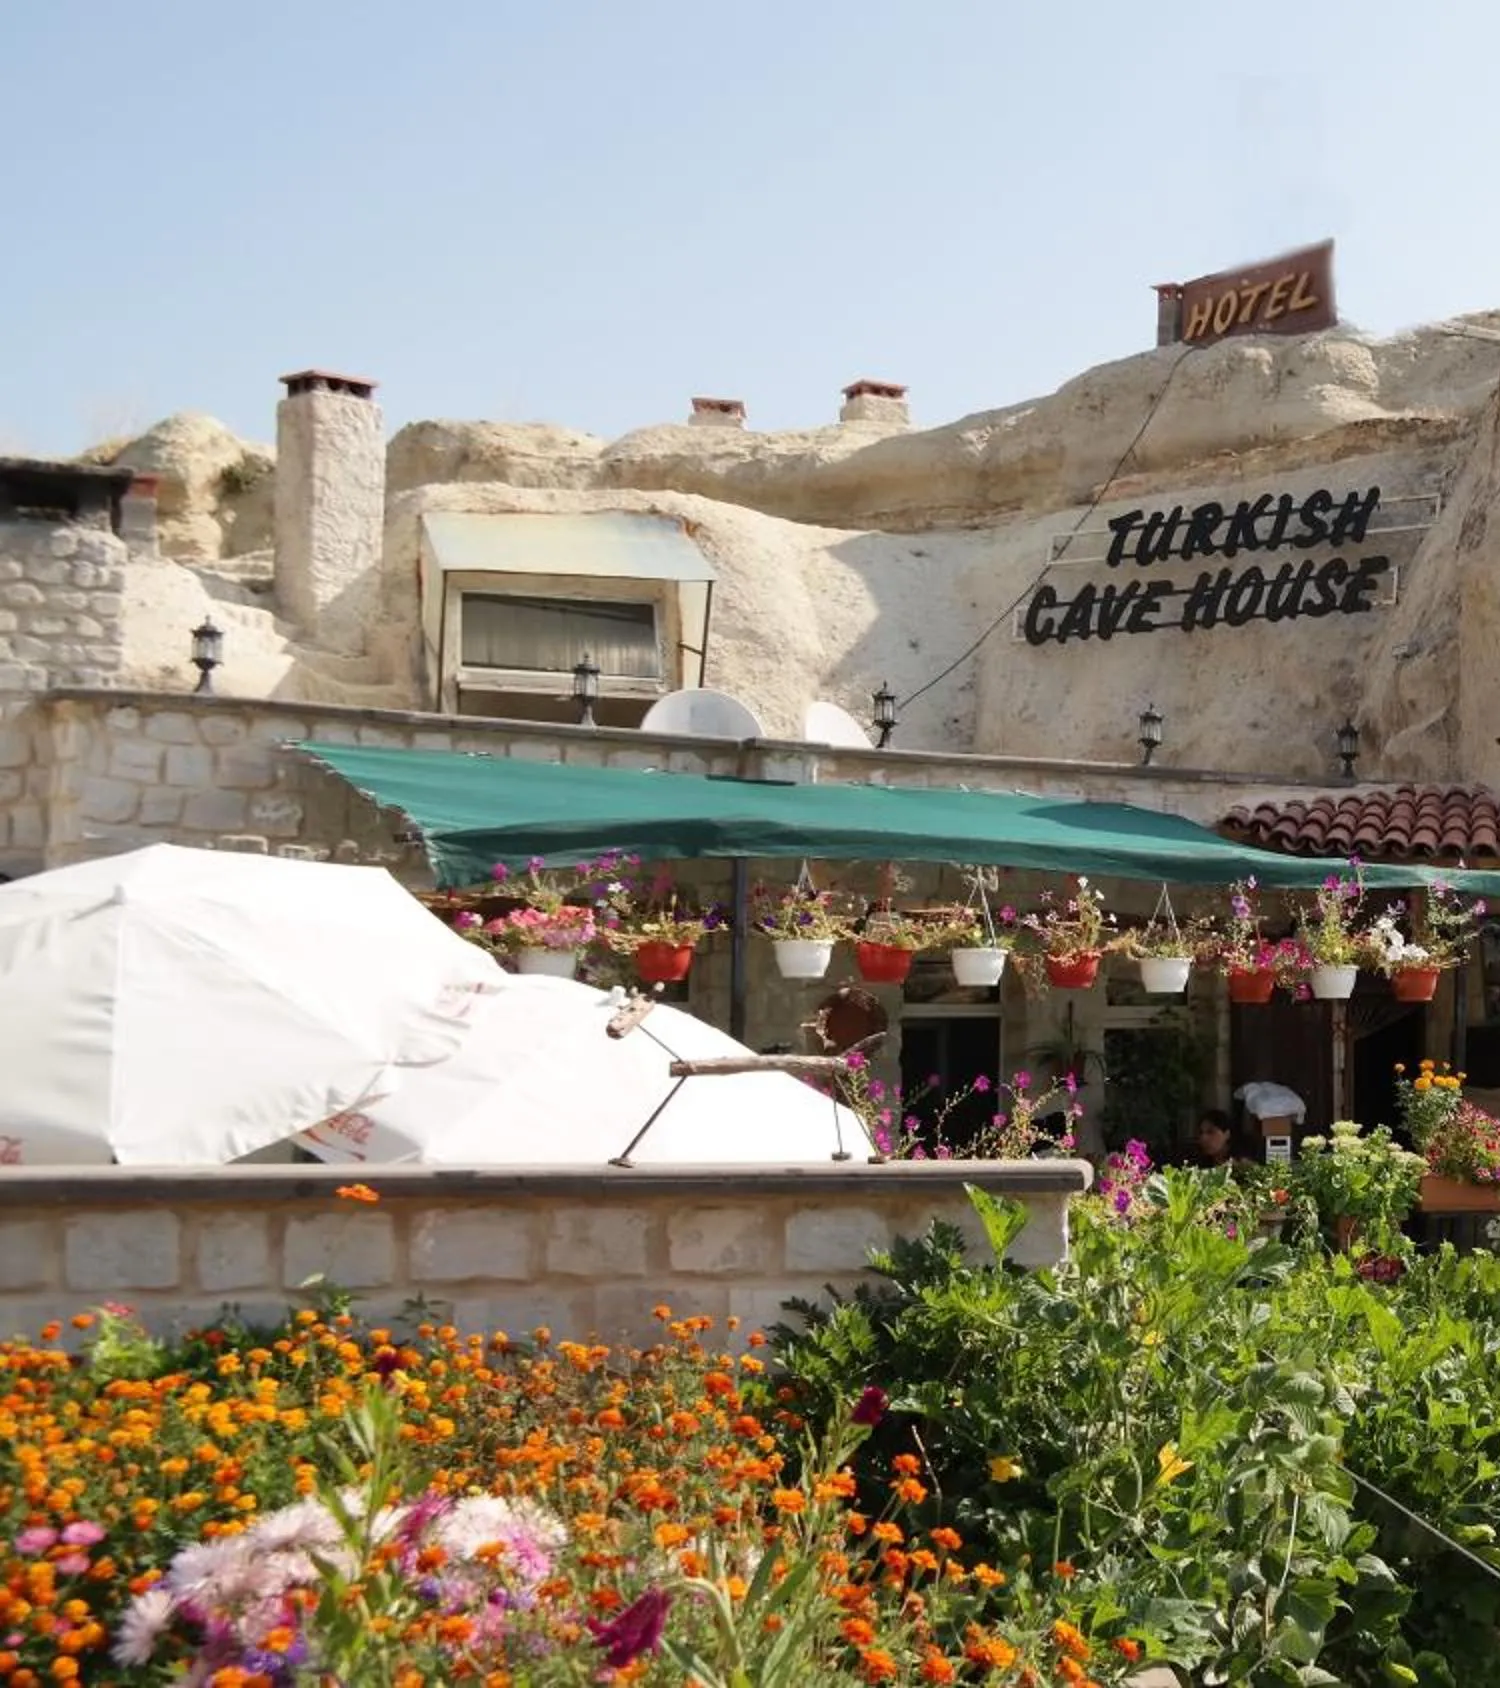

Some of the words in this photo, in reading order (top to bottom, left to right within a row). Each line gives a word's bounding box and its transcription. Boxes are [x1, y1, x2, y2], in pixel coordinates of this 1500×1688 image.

[1184, 271, 1318, 342] HOTEL
[1106, 486, 1382, 567] TURKISH
[1025, 579, 1173, 646] CAVE
[1181, 555, 1390, 632] HOUSE
